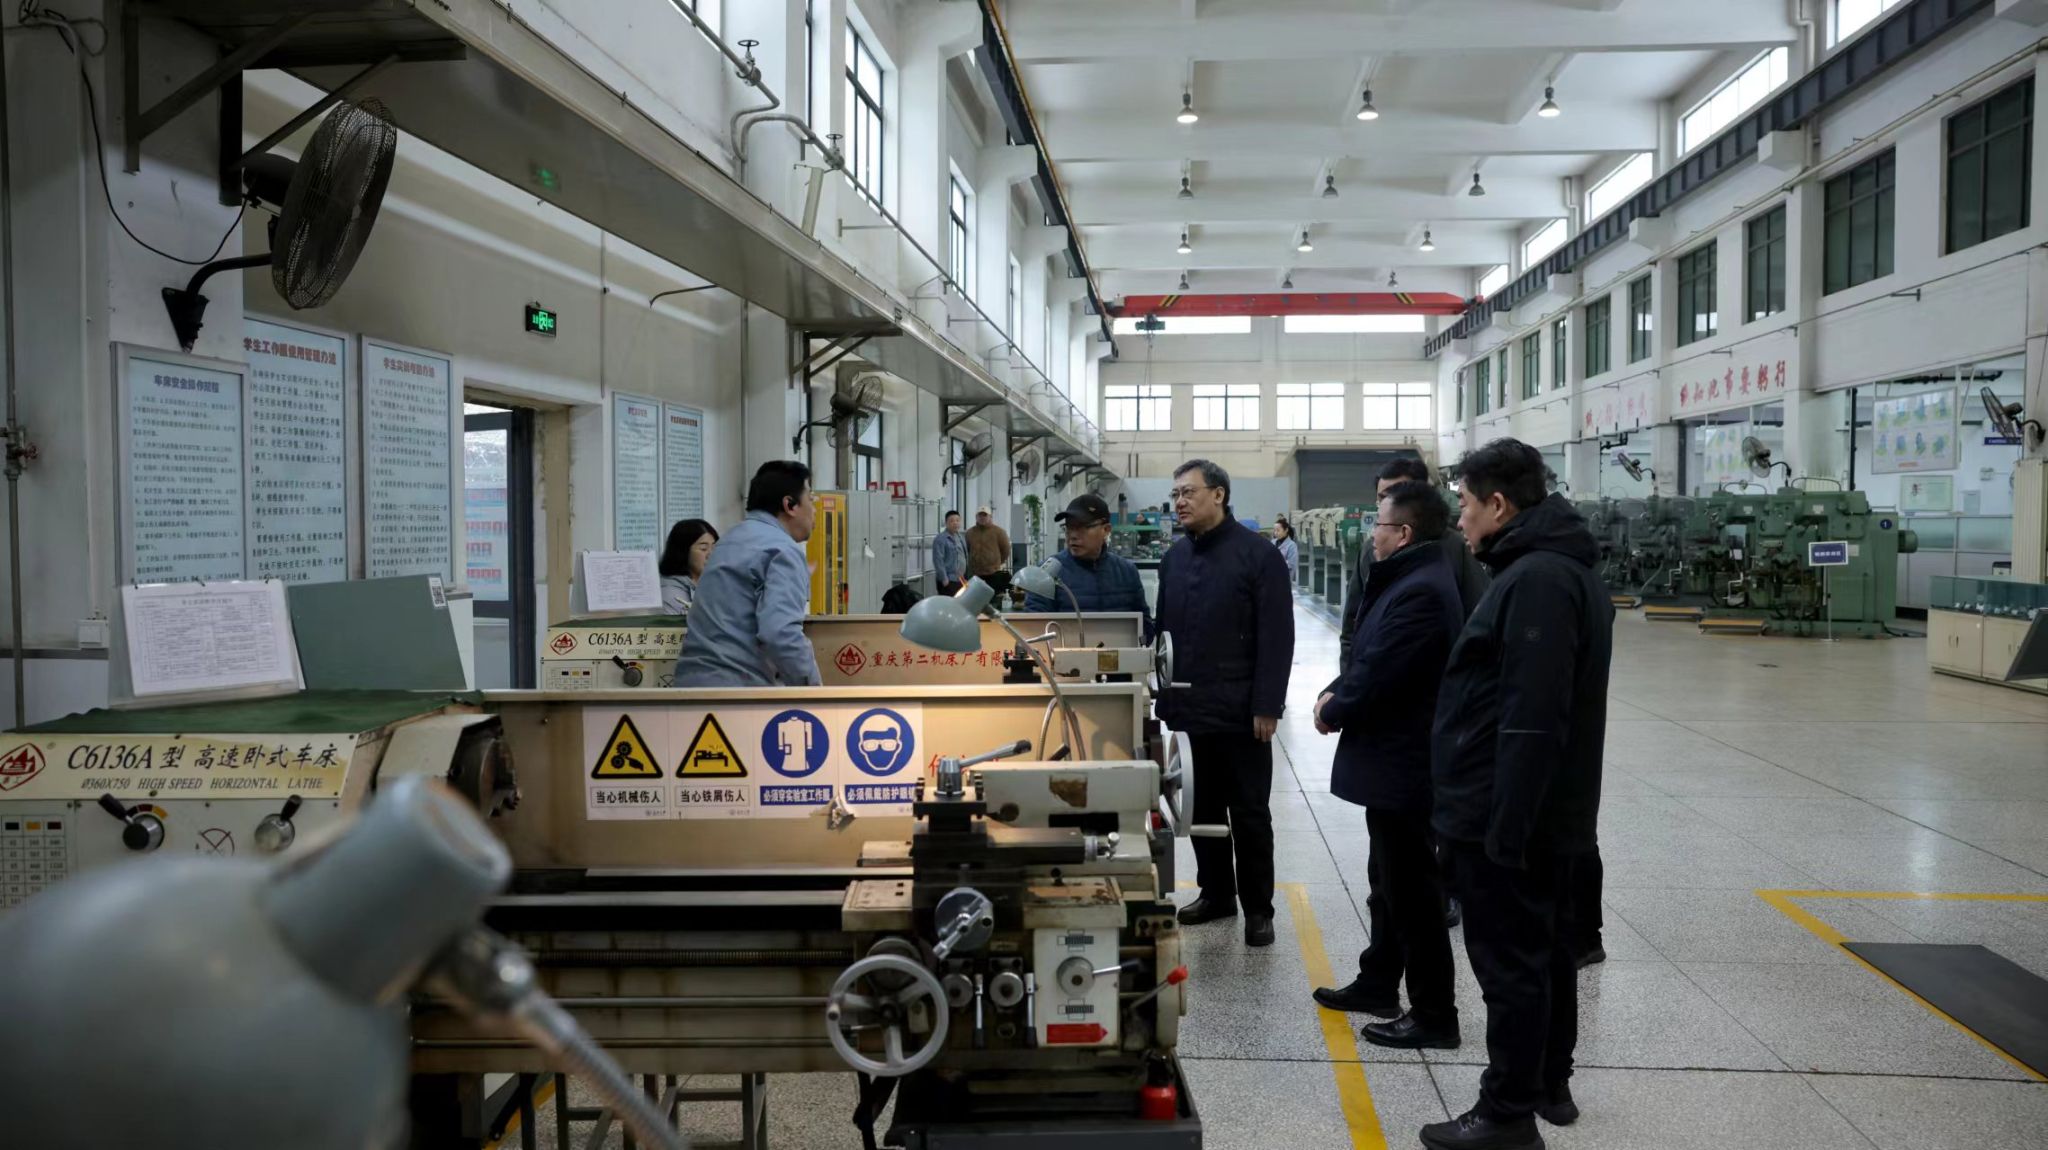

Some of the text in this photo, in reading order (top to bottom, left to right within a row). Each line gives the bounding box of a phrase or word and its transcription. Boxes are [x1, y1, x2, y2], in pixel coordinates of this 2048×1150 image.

[588, 632, 633, 646] C6136A
[637, 632, 649, 646] 型
[870, 650, 1014, 668] 重庆第二机床厂有限
[67, 742, 338, 770] C6136A 型 高速卧式车床
[137, 777, 166, 790] HIGH
[167, 777, 203, 790] SPEED
[210, 777, 279, 790] HORIZONTAL
[287, 777, 324, 790] LATHE
[596, 790, 661, 804] 当心机械伤人
[681, 788, 745, 803] 当心铁屑伤人
[763, 787, 831, 803] 必须穿实验室工作服
